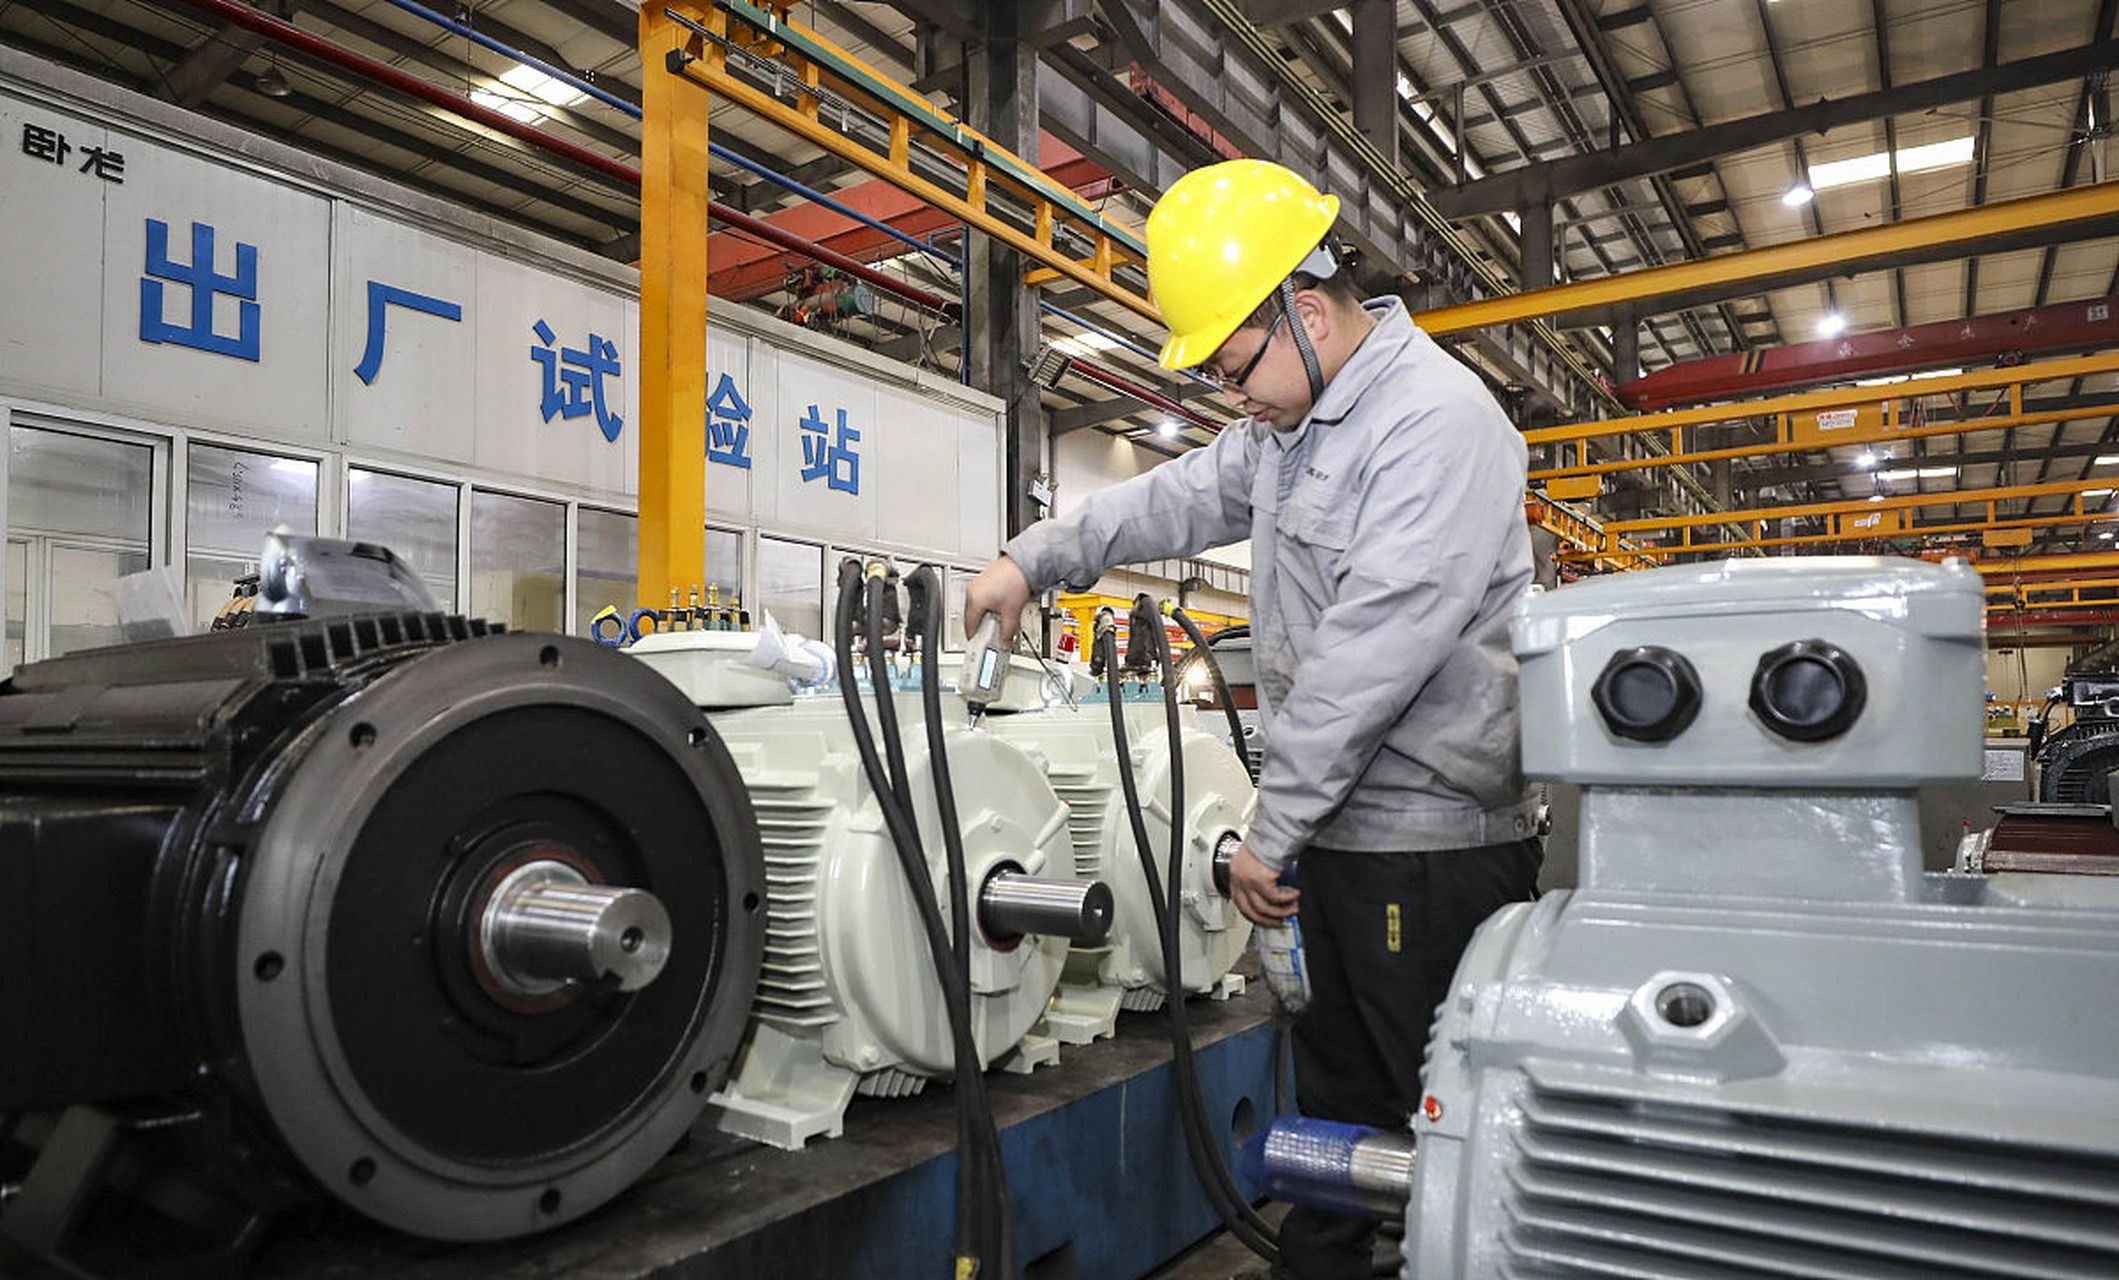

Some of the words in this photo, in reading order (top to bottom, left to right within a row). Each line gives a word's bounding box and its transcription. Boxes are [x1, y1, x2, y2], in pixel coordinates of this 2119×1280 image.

[139, 217, 861, 497] 出厂试验站
